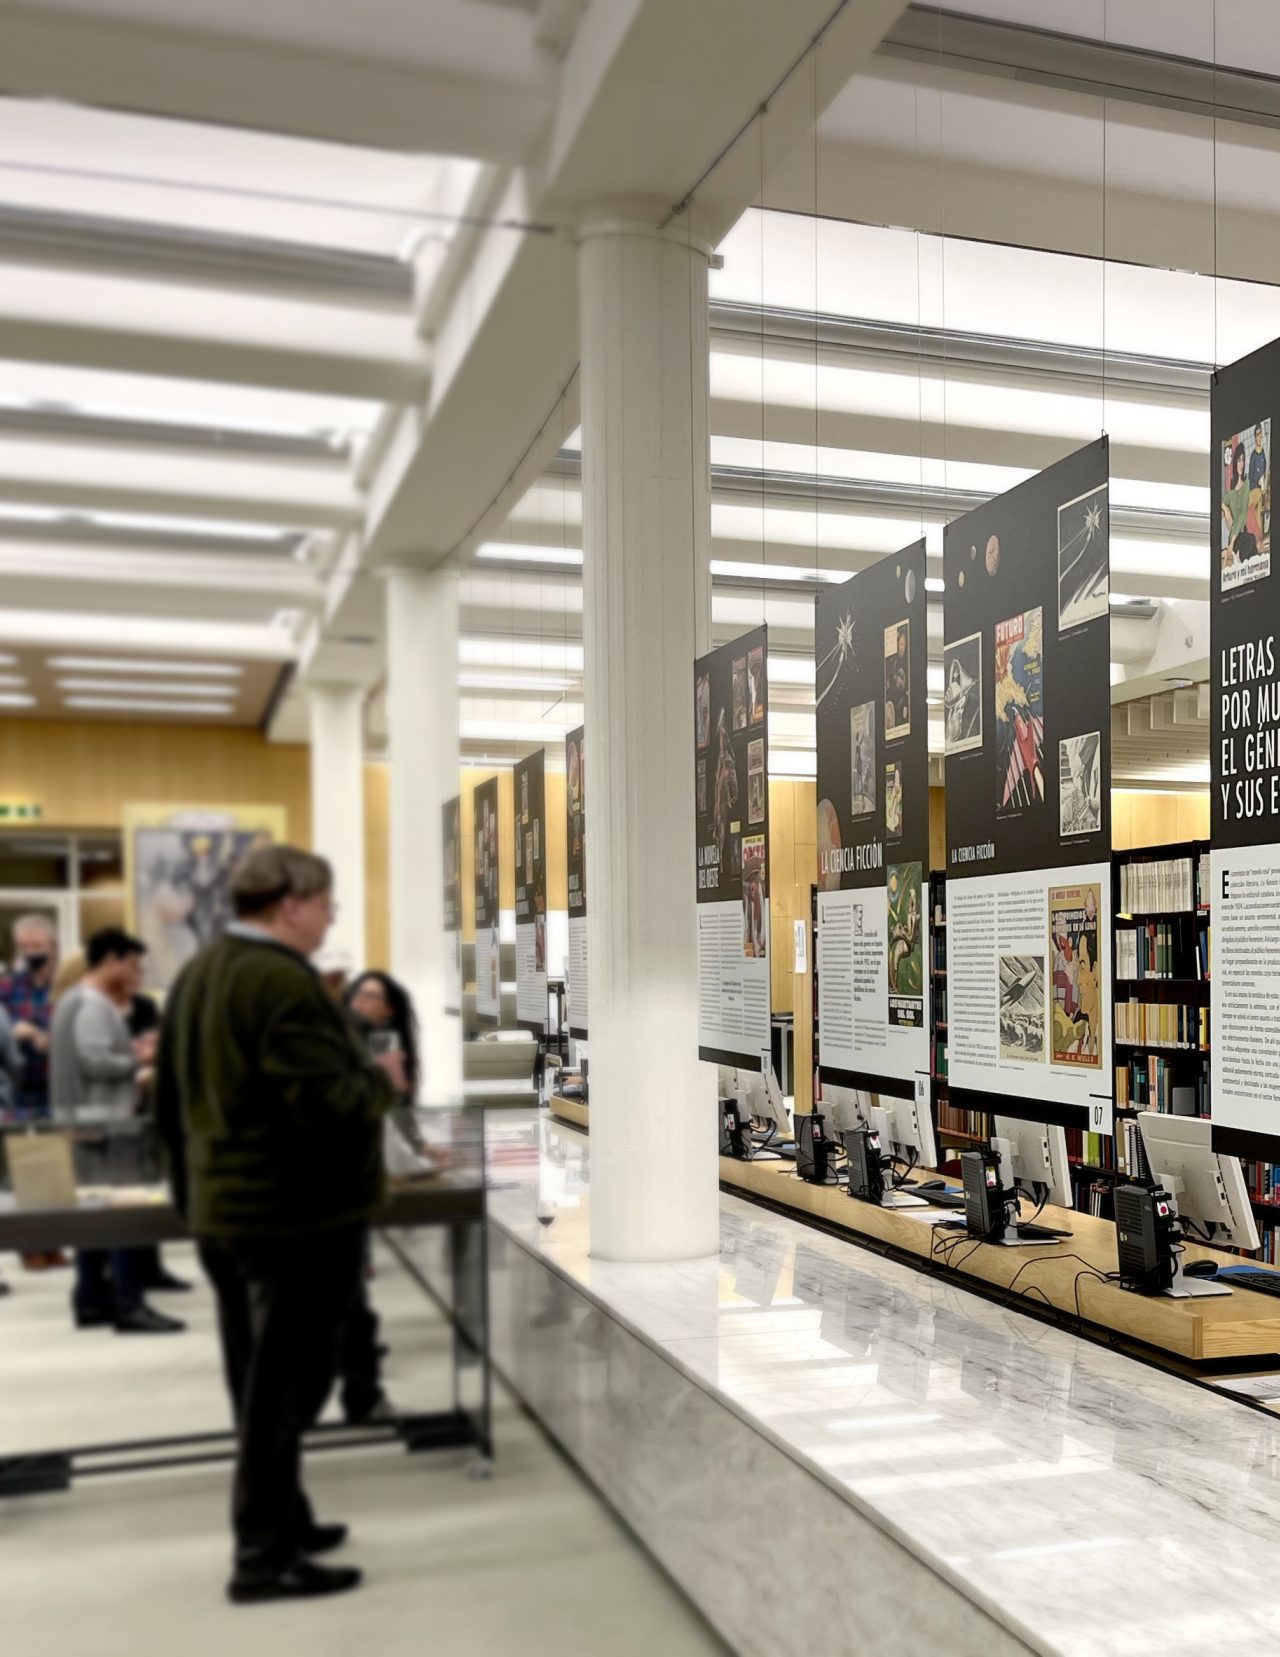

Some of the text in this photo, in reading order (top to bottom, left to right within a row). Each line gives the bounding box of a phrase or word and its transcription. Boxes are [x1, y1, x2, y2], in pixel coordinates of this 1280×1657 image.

[1221, 636, 1275, 687] LETRAS
[1222, 689, 1251, 732] POR
[1221, 738, 1237, 776] EL
[1221, 783, 1230, 820] Y
[1236, 777, 1264, 819] SUS
[821, 837, 883, 875] LA CIENCIA FICCIÓN
[1094, 1105, 1103, 1125] 07
